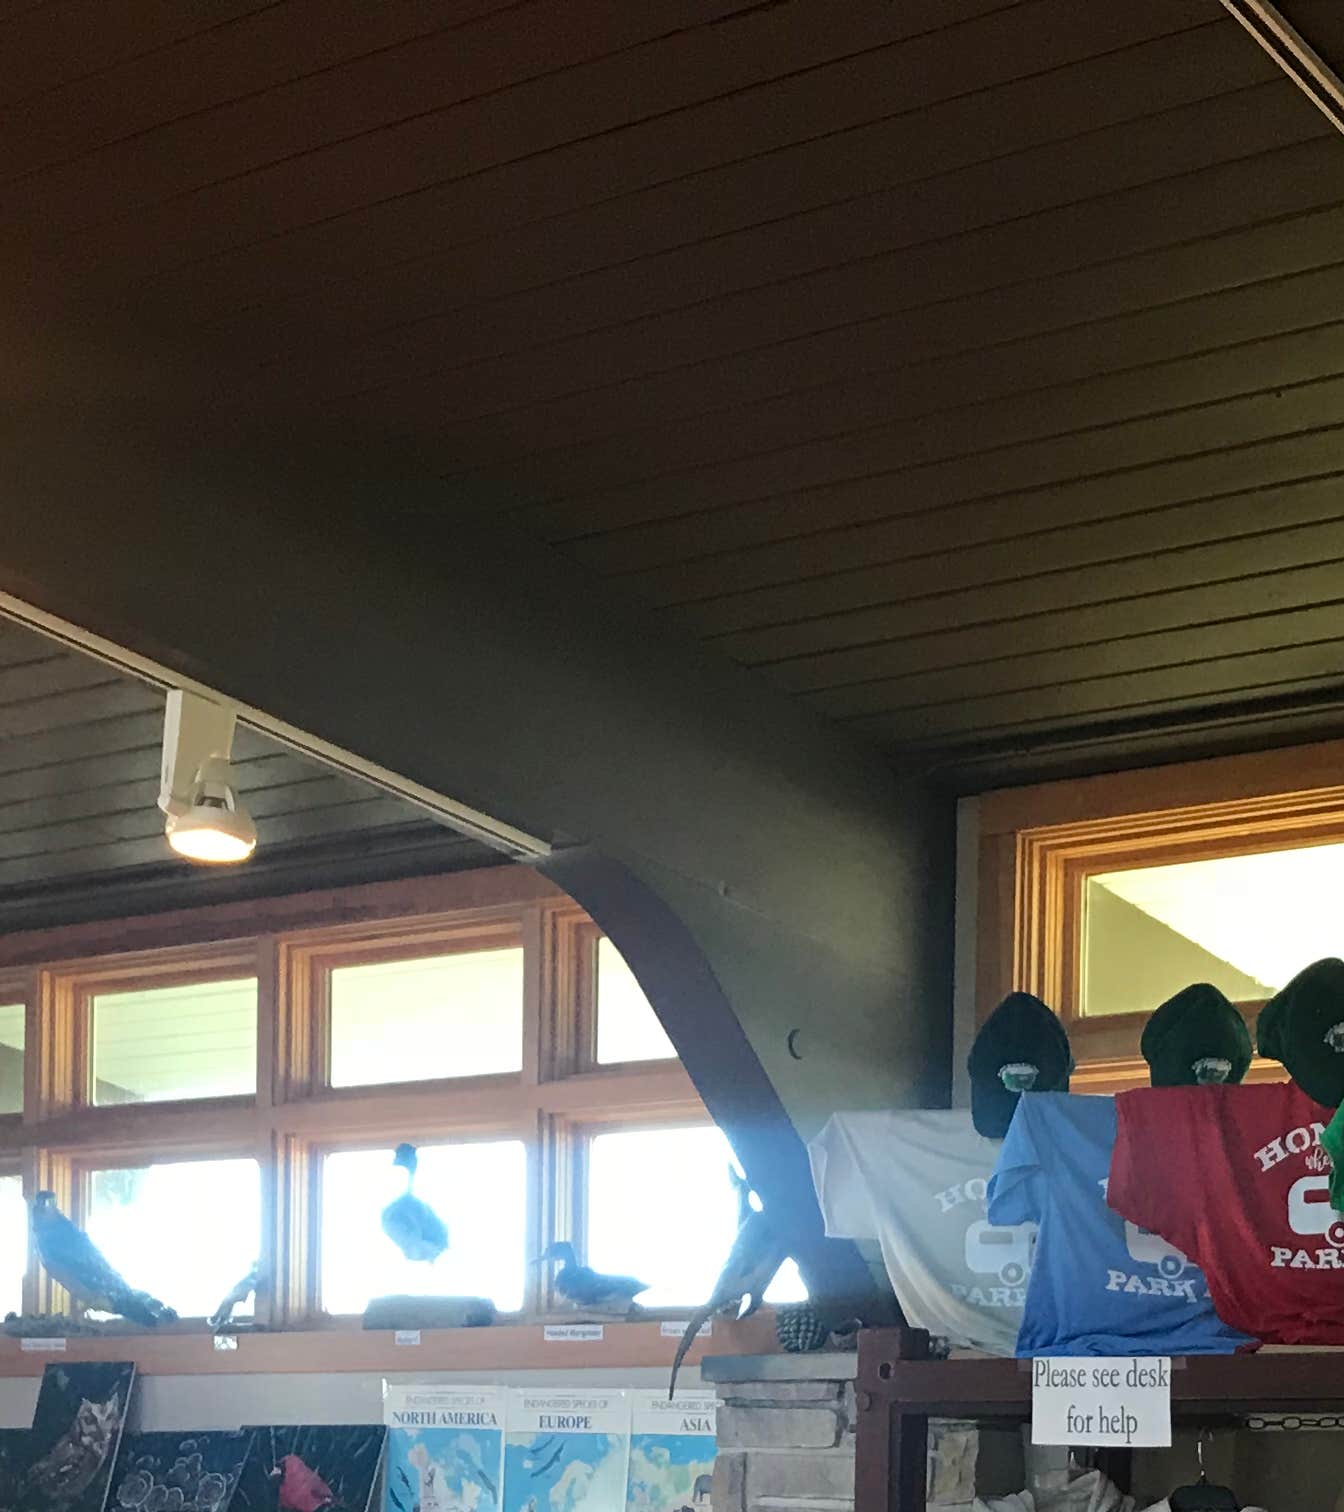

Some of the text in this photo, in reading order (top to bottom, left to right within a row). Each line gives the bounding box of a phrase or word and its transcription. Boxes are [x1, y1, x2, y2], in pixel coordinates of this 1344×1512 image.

[1254, 1123, 1326, 1171] HO
[1306, 1148, 1335, 1171] whe
[933, 1178, 988, 1212] HO
[1106, 1270, 1197, 1303] PARK
[1034, 1359, 1169, 1388] Please see desk
[392, 1411, 498, 1426] NORTH AMERICA
[539, 1415, 593, 1429] EUROPE
[680, 1418, 712, 1432] ASIA
[1067, 1404, 1138, 1444] for help
